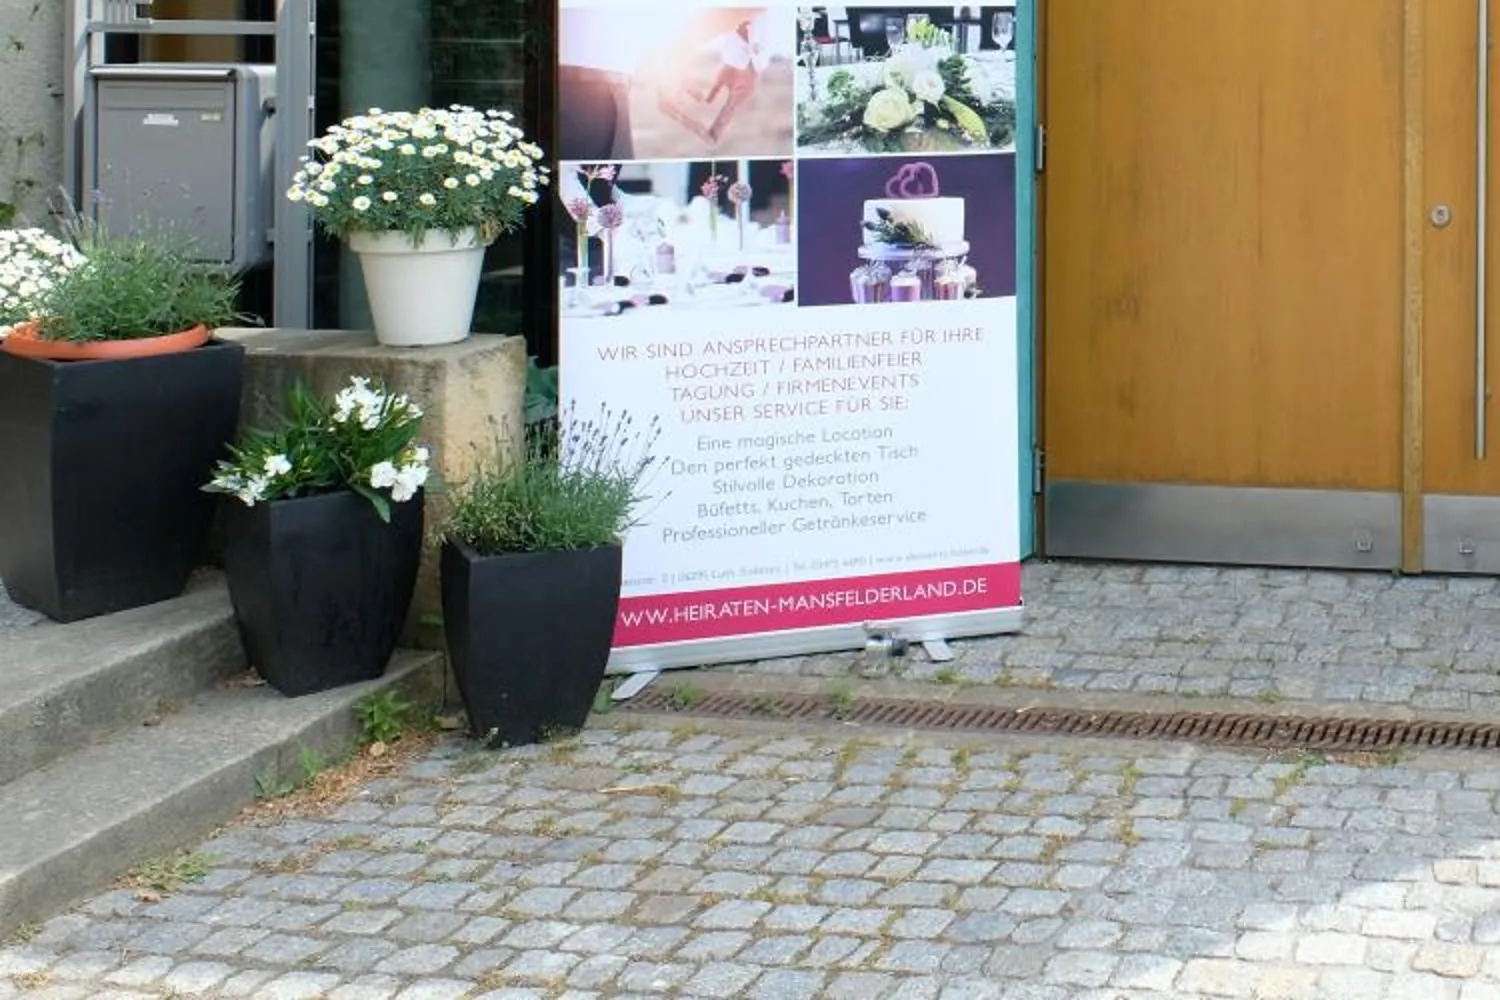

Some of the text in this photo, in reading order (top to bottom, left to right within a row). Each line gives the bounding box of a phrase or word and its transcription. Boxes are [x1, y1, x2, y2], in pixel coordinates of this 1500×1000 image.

[597, 327, 984, 361] WIR SIND ANSPRECHPARTNER FÜR IHRE
[665, 360, 769, 379] HOCHZEIT
[793, 351, 923, 372] FAMILIENFEIER
[671, 383, 755, 401] TAGUNG
[777, 373, 920, 396] FIRMENEVENTS
[681, 406, 744, 423] UNSER
[753, 400, 828, 419] SERVICE
[697, 427, 893, 451] Eine magische Location
[671, 444, 918, 475] Den perfekt gedeckten Tisch
[712, 470, 879, 495] Stilvolle Dekoration
[767, 495, 833, 513] Kuchen,
[840, 490, 893, 507] Torten
[662, 508, 927, 544] Professioneller Getränkeservice
[621, 578, 988, 627] WW.HEIRATEN-MANSFELDERLAND.DE
